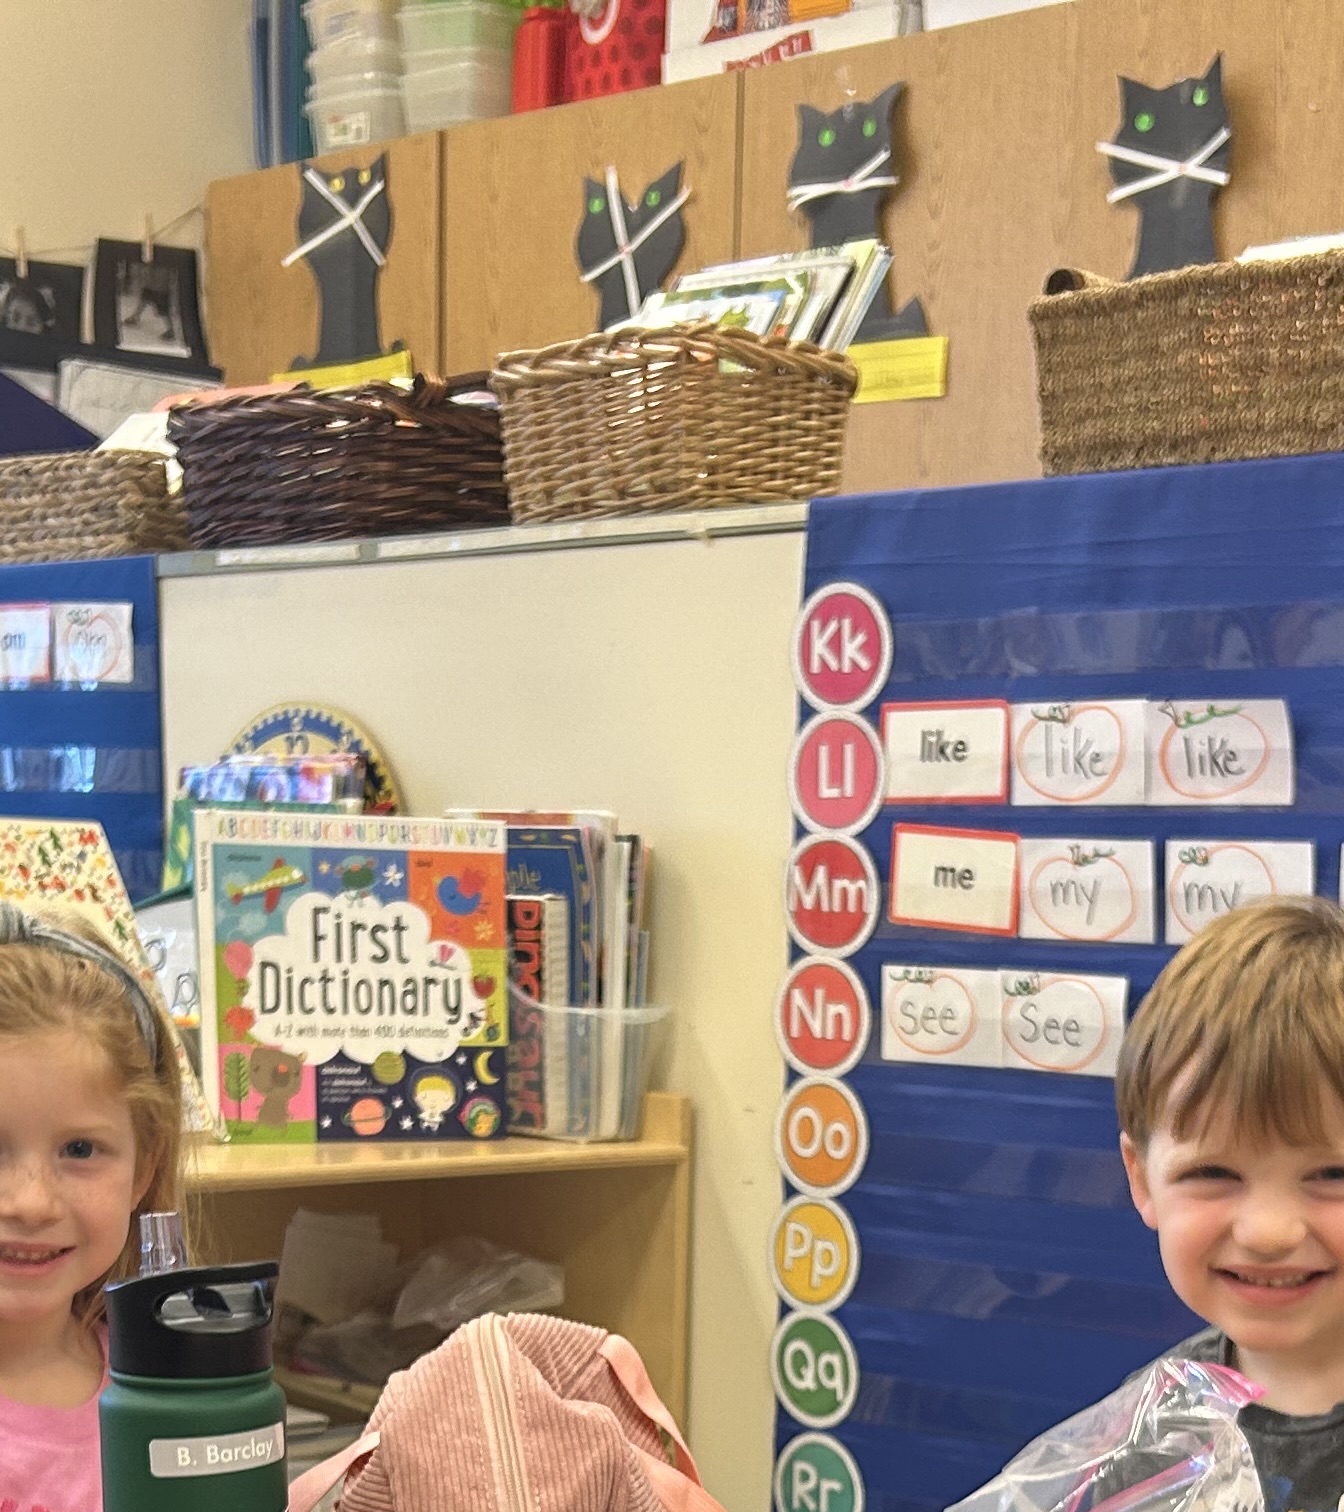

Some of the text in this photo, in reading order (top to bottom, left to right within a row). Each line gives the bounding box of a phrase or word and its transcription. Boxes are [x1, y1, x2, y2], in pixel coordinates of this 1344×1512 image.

[809, 616, 872, 674] Kk
[919, 728, 969, 763] like
[1044, 723, 1108, 780] like
[1183, 735, 1246, 779] like
[789, 863, 870, 914] Mm
[933, 863, 976, 891] me
[1049, 878, 1102, 927] my
[312, 906, 409, 964] First
[259, 961, 463, 1025] Dictionary
[788, 987, 853, 1042] Nn
[788, 1105, 851, 1160] Oo
[783, 1221, 841, 1288] Pp
[783, 1338, 844, 1402] Qq
[176, 1437, 274, 1467] B. Barclay
